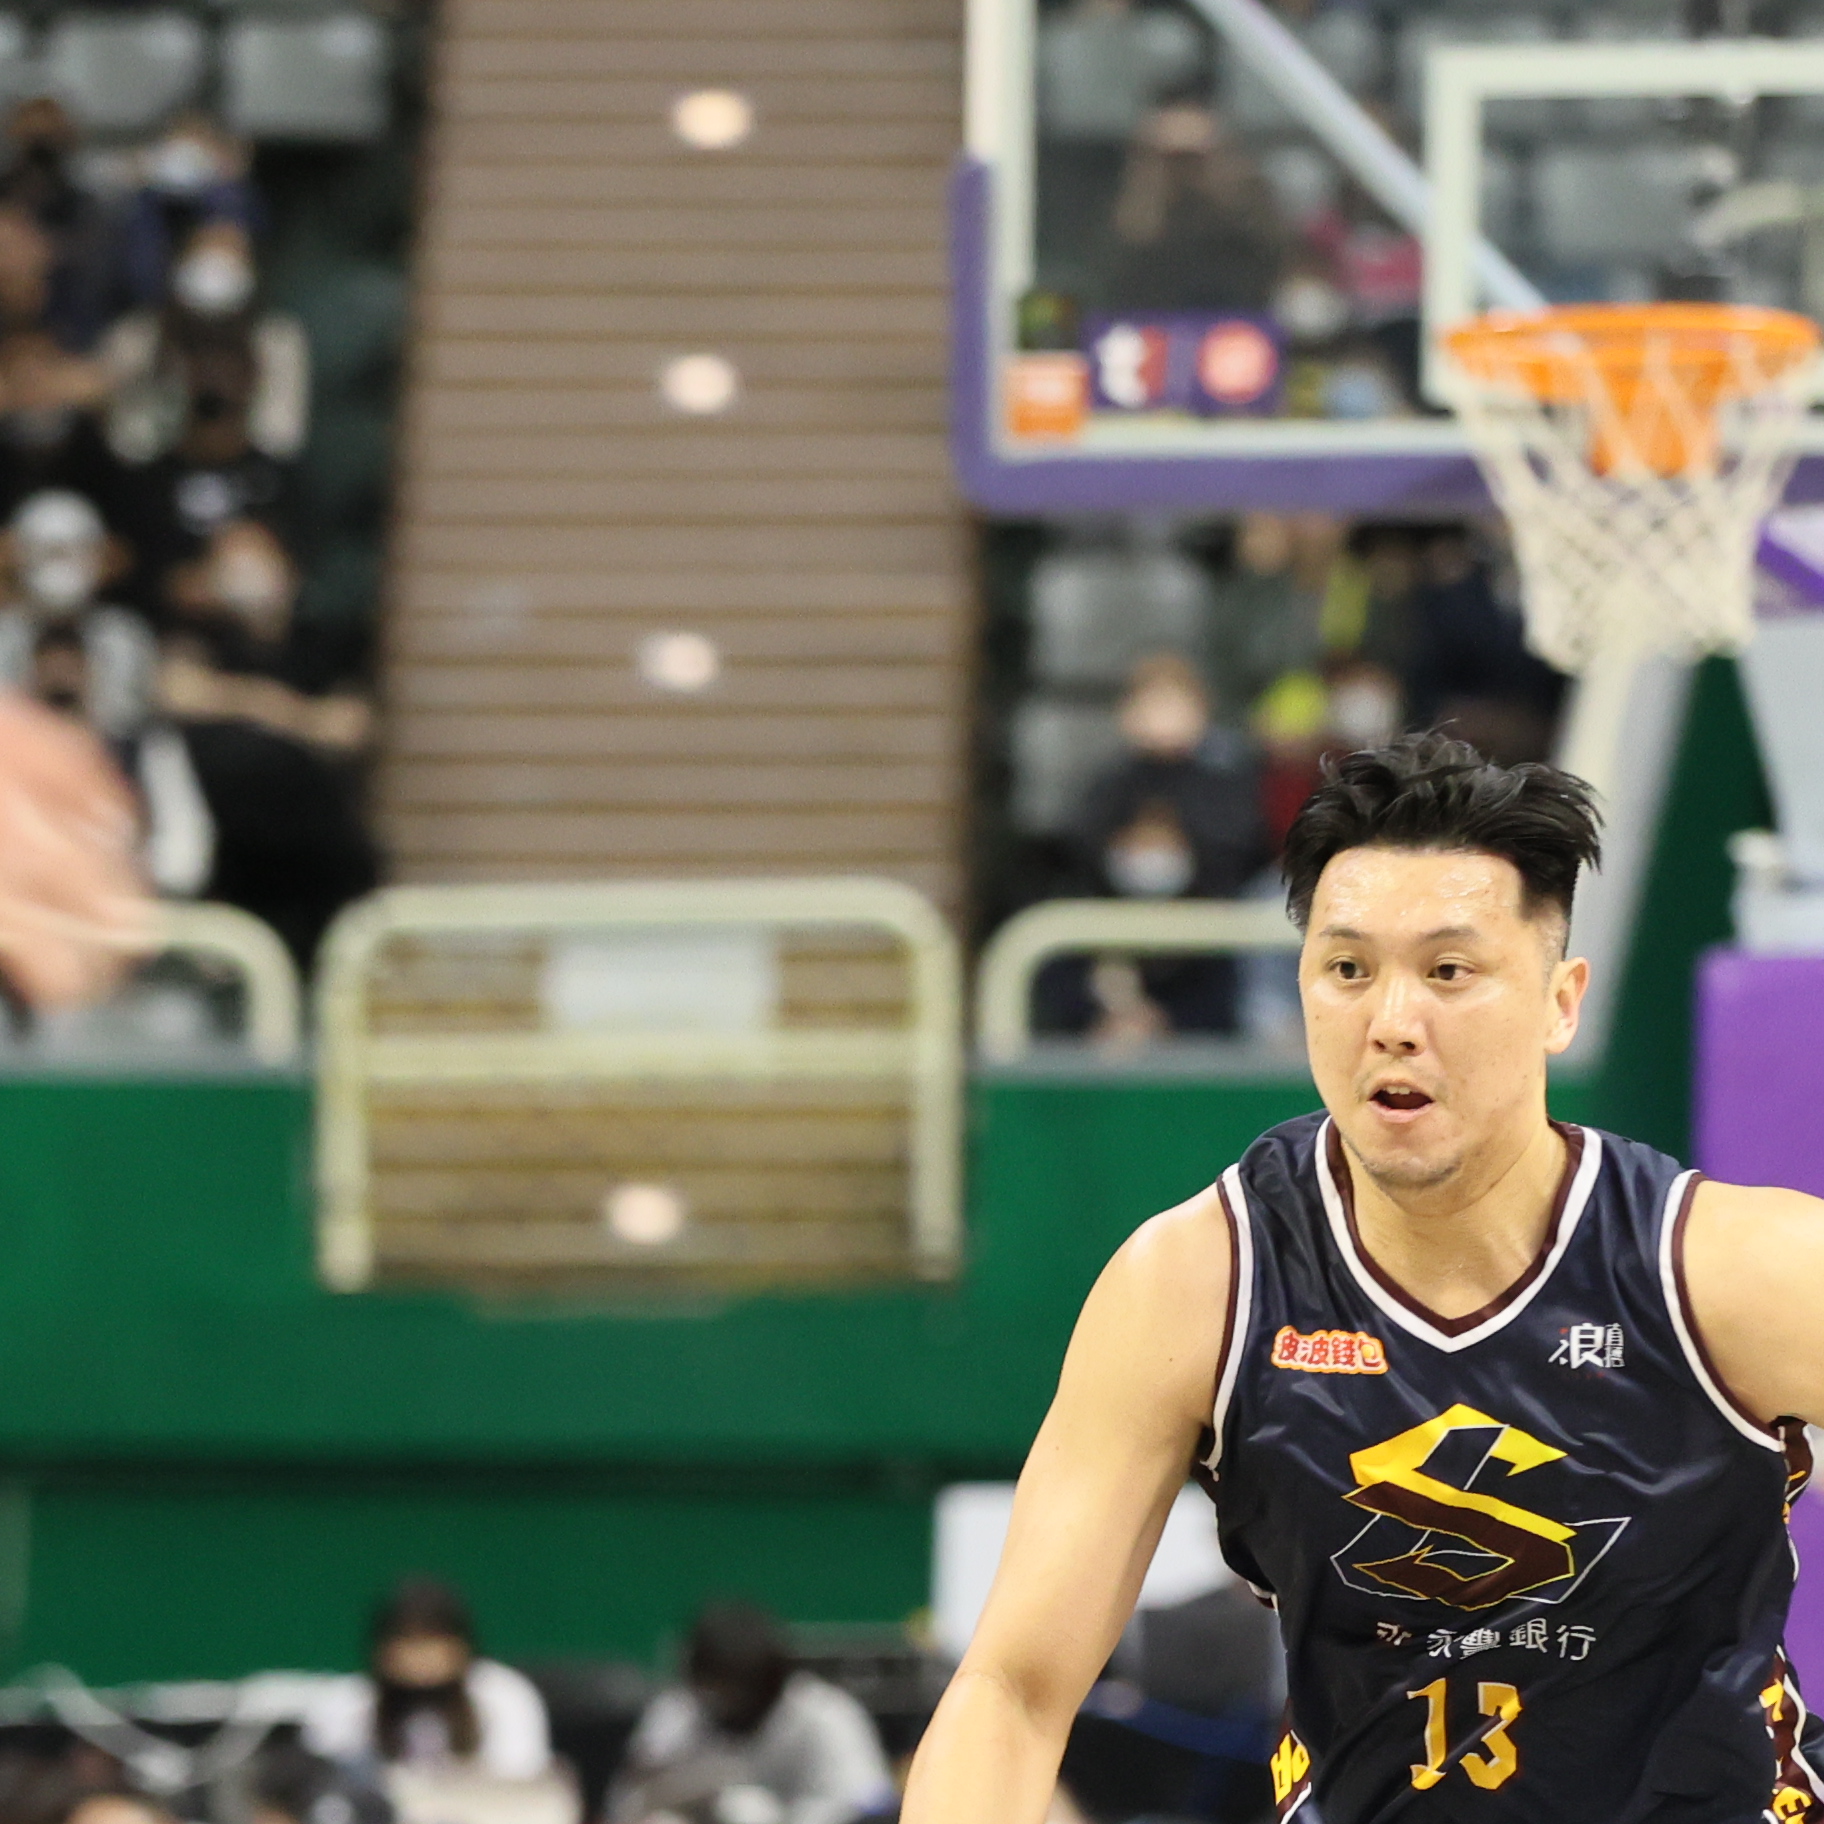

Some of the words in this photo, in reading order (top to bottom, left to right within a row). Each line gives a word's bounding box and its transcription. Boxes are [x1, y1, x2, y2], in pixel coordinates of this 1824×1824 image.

[1426, 1617, 1597, 1661] 永豐銀行
[1406, 1677, 1523, 1791] 13
